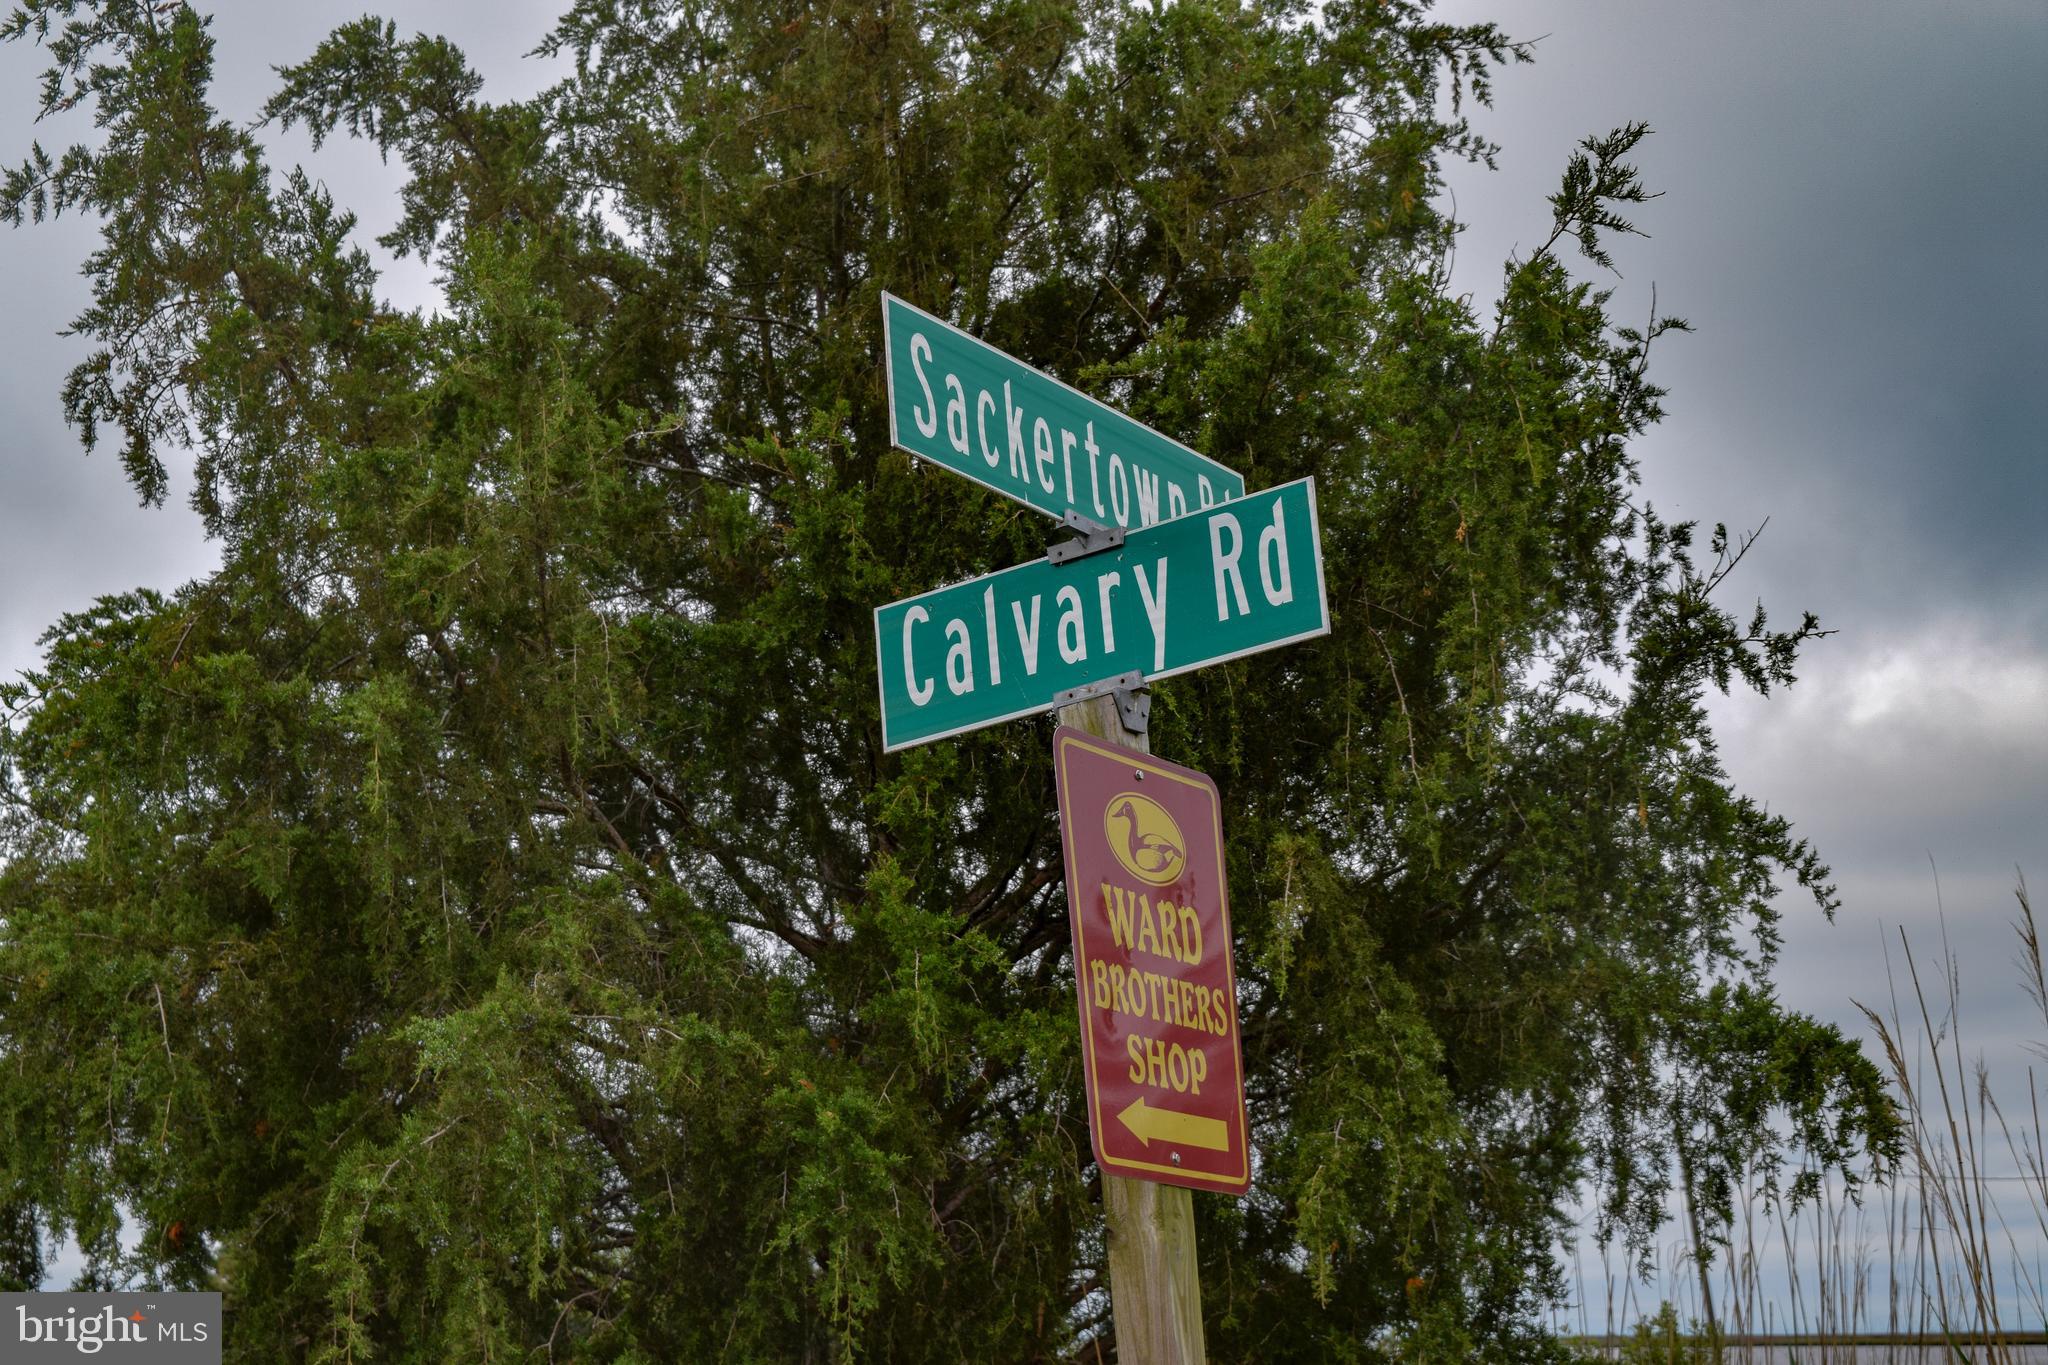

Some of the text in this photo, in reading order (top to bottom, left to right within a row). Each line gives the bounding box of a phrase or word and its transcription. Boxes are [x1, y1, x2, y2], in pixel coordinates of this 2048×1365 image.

[910, 332, 1230, 528] Sackertown R
[902, 496, 1294, 707] Calvary Rd
[1101, 883, 1203, 966] WARD
[1090, 959, 1228, 1037] BROTHERS
[1127, 1033, 1207, 1095] SHOP
